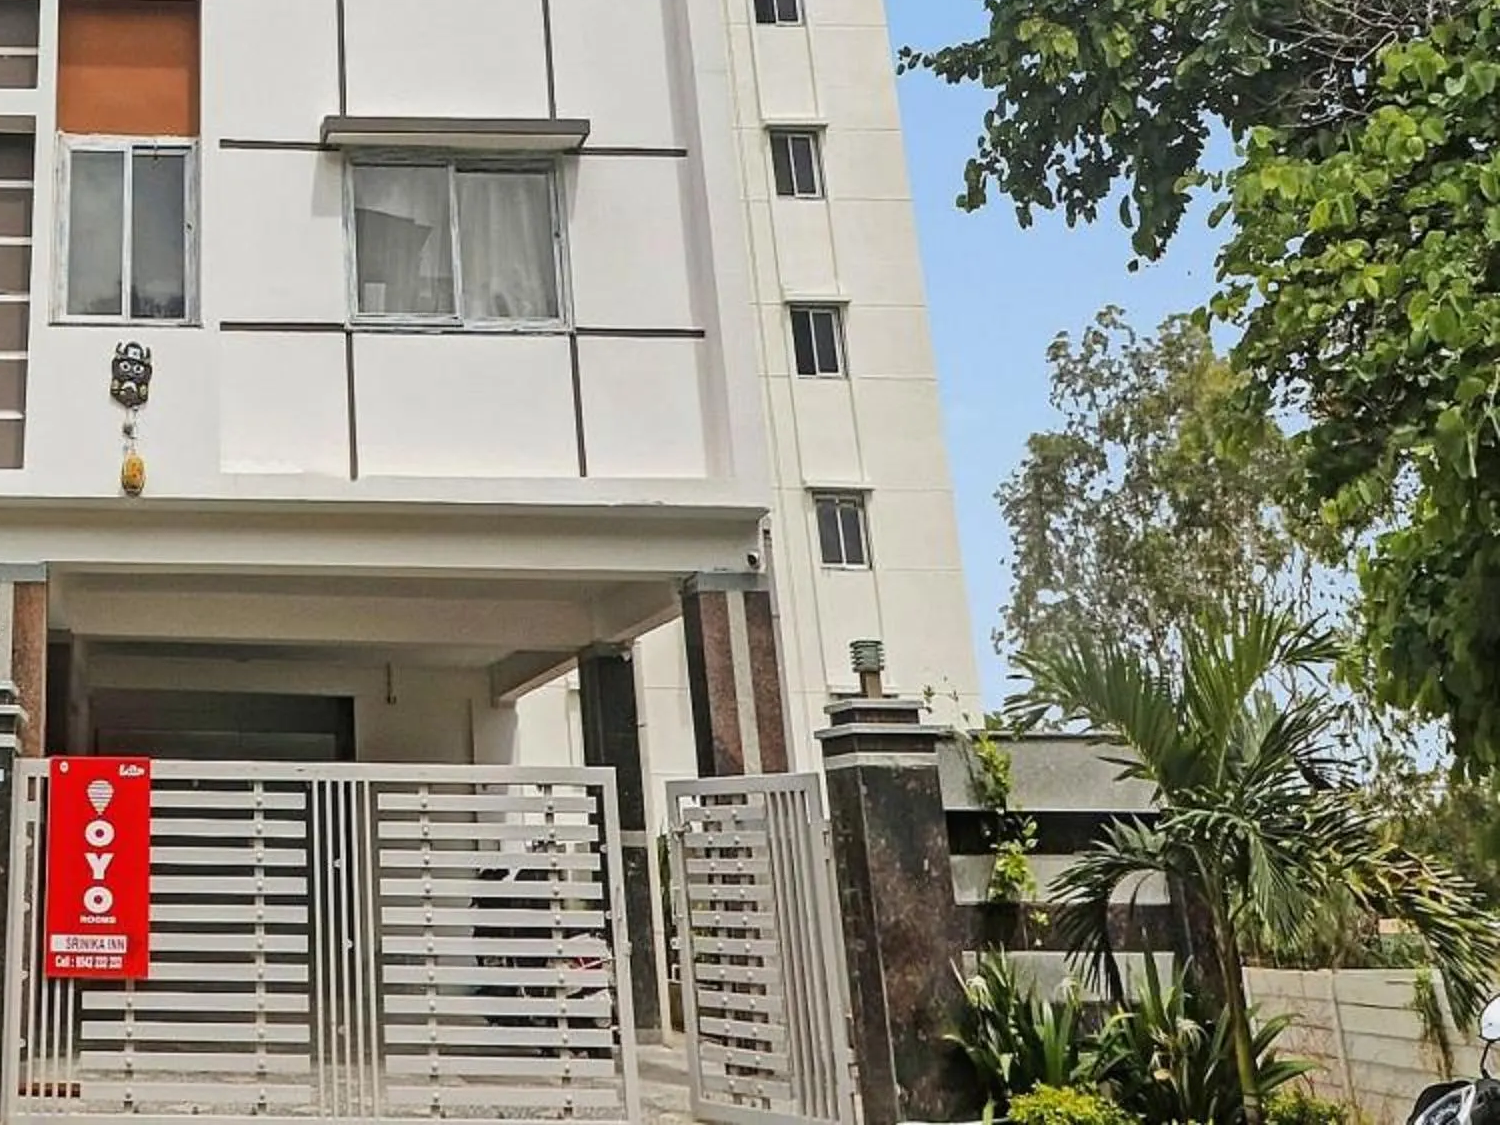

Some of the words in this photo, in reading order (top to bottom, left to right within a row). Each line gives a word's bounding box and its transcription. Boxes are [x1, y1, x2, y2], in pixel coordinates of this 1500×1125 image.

[83, 819, 116, 914] OYO
[79, 915, 117, 924] ROOMS
[107, 938, 125, 951] INN
